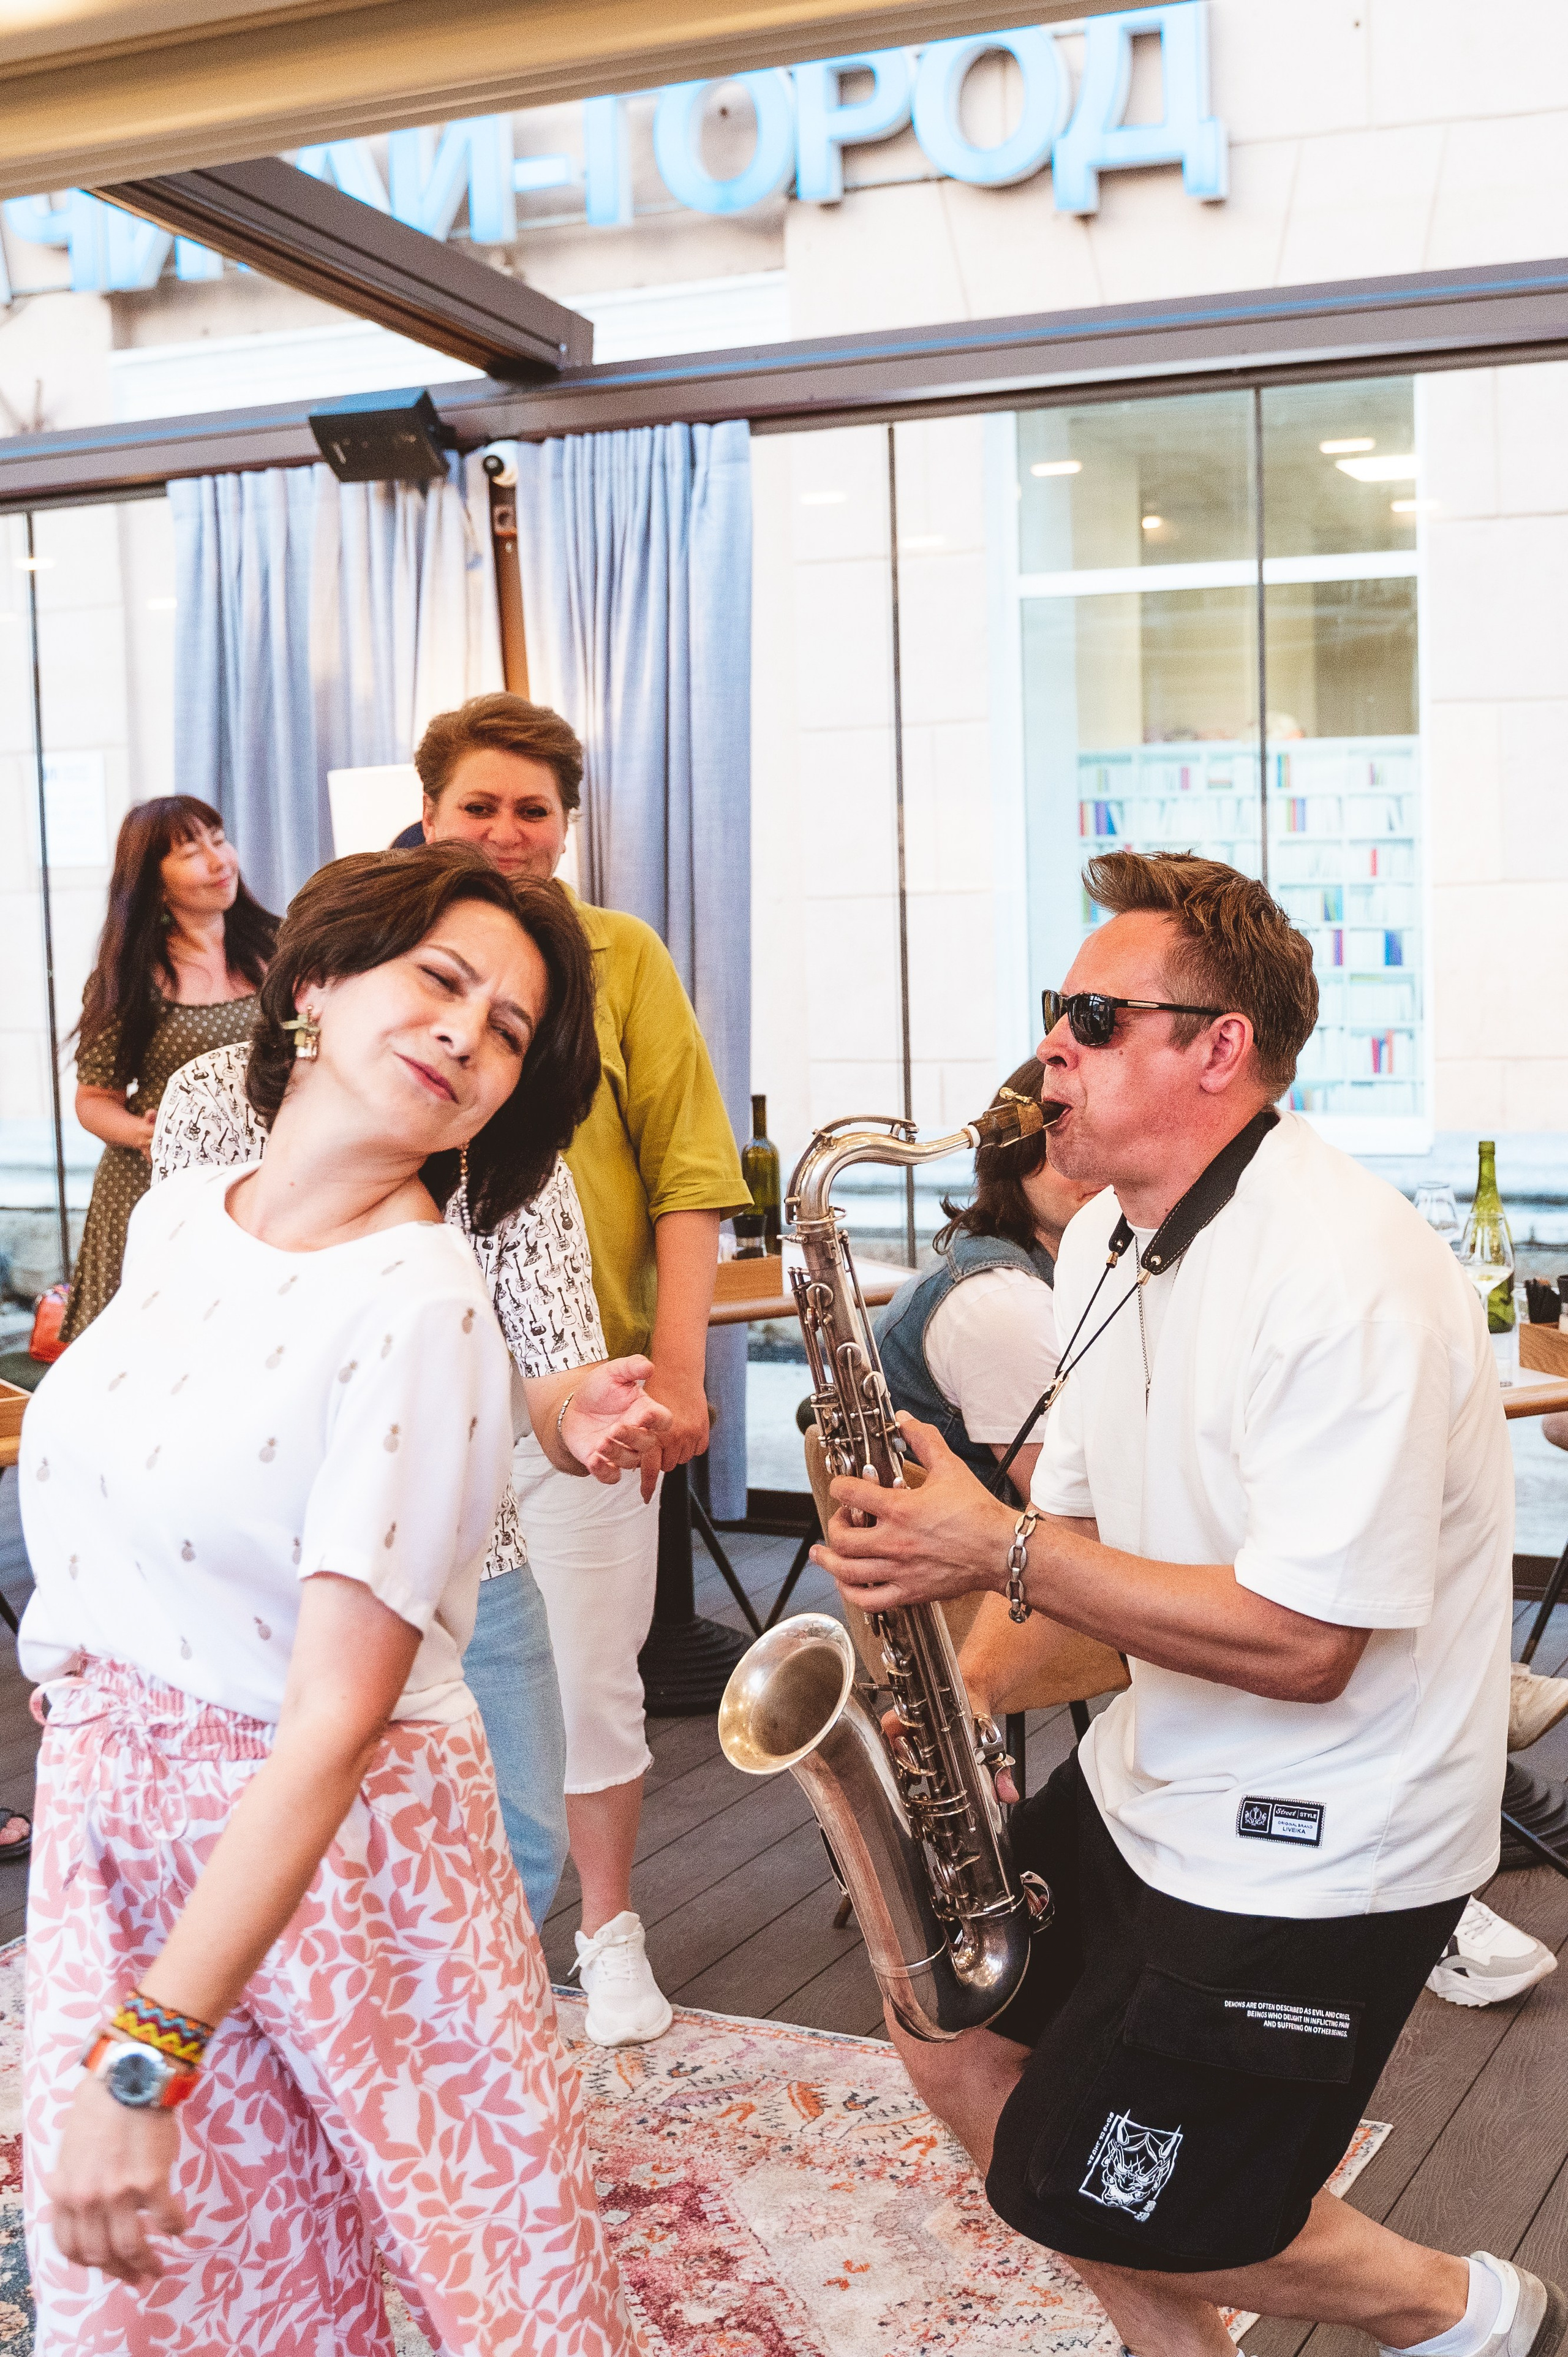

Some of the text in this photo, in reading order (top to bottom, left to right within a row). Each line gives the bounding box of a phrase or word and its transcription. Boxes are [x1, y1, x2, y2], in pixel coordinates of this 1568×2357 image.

[1276, 2004, 1303, 2014] DESCRIBED
[1283, 2014, 1303, 2022] DELIGHT
[1310, 2018, 1338, 2027] INFLICTING
[1278, 2022, 1303, 2031] SUFFERING
